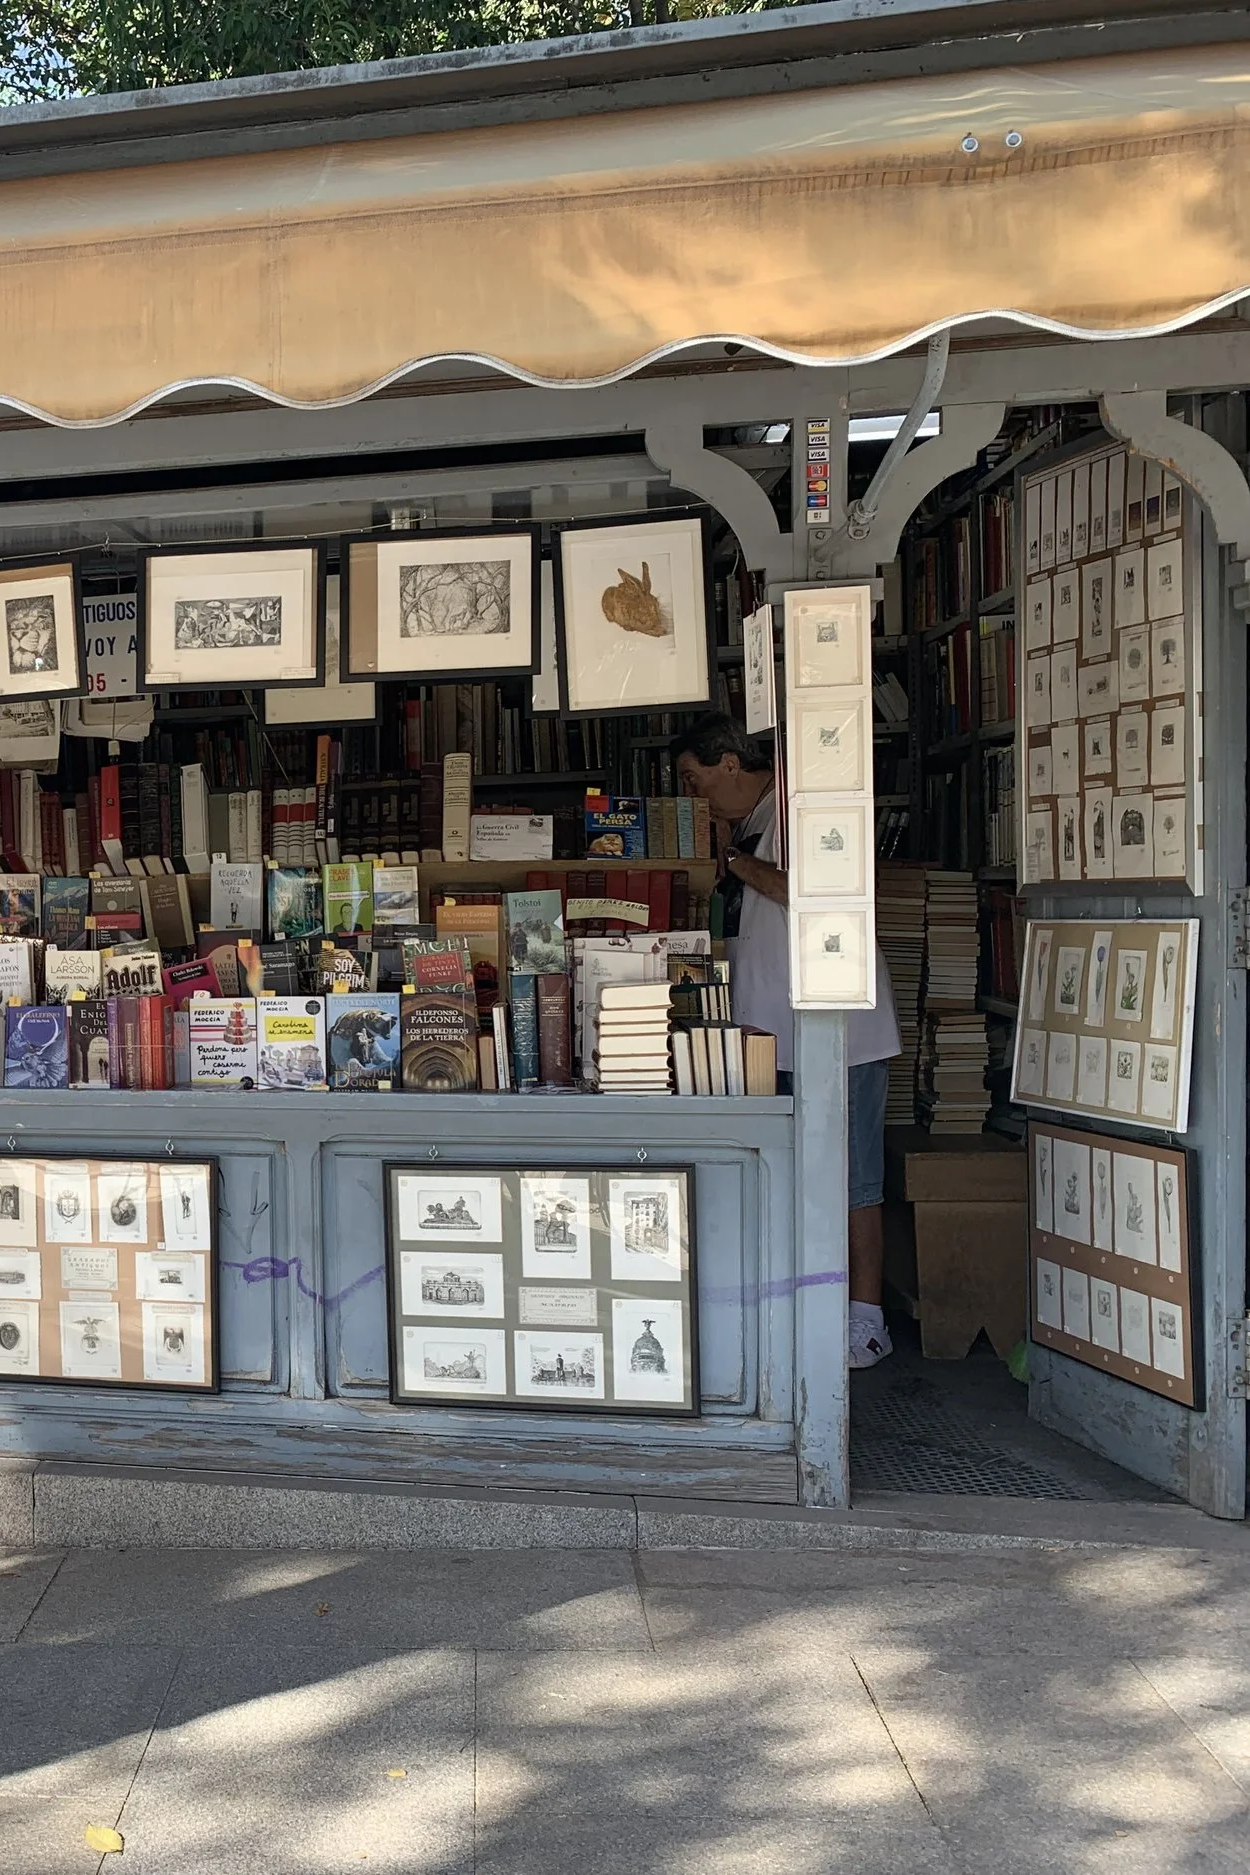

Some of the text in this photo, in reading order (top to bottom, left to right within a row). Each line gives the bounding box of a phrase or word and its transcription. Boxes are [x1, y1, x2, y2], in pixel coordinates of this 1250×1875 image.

[83, 601, 136, 624] TIGUOS
[609, 813, 638, 821] GATO
[50, 965, 95, 974] LARSSON
[333, 958, 354, 973] SOY
[421, 964, 458, 974] CORNELIA
[104, 963, 158, 991] Adolf
[323, 971, 365, 987] PILGRIM
[80, 1009, 107, 1019] ENIG
[415, 1009, 459, 1017] ILDEFONSO
[272, 1020, 308, 1029] Carolina
[410, 1015, 464, 1024] FALCONES
[79, 1025, 109, 1035] CUAT
[405, 1027, 469, 1035] LOS HEREDEROS
[196, 1044, 229, 1054] Perdona
[199, 1054, 226, 1066] quiero
[197, 1068, 232, 1079] contigo
[333, 1070, 379, 1089] DORAD
